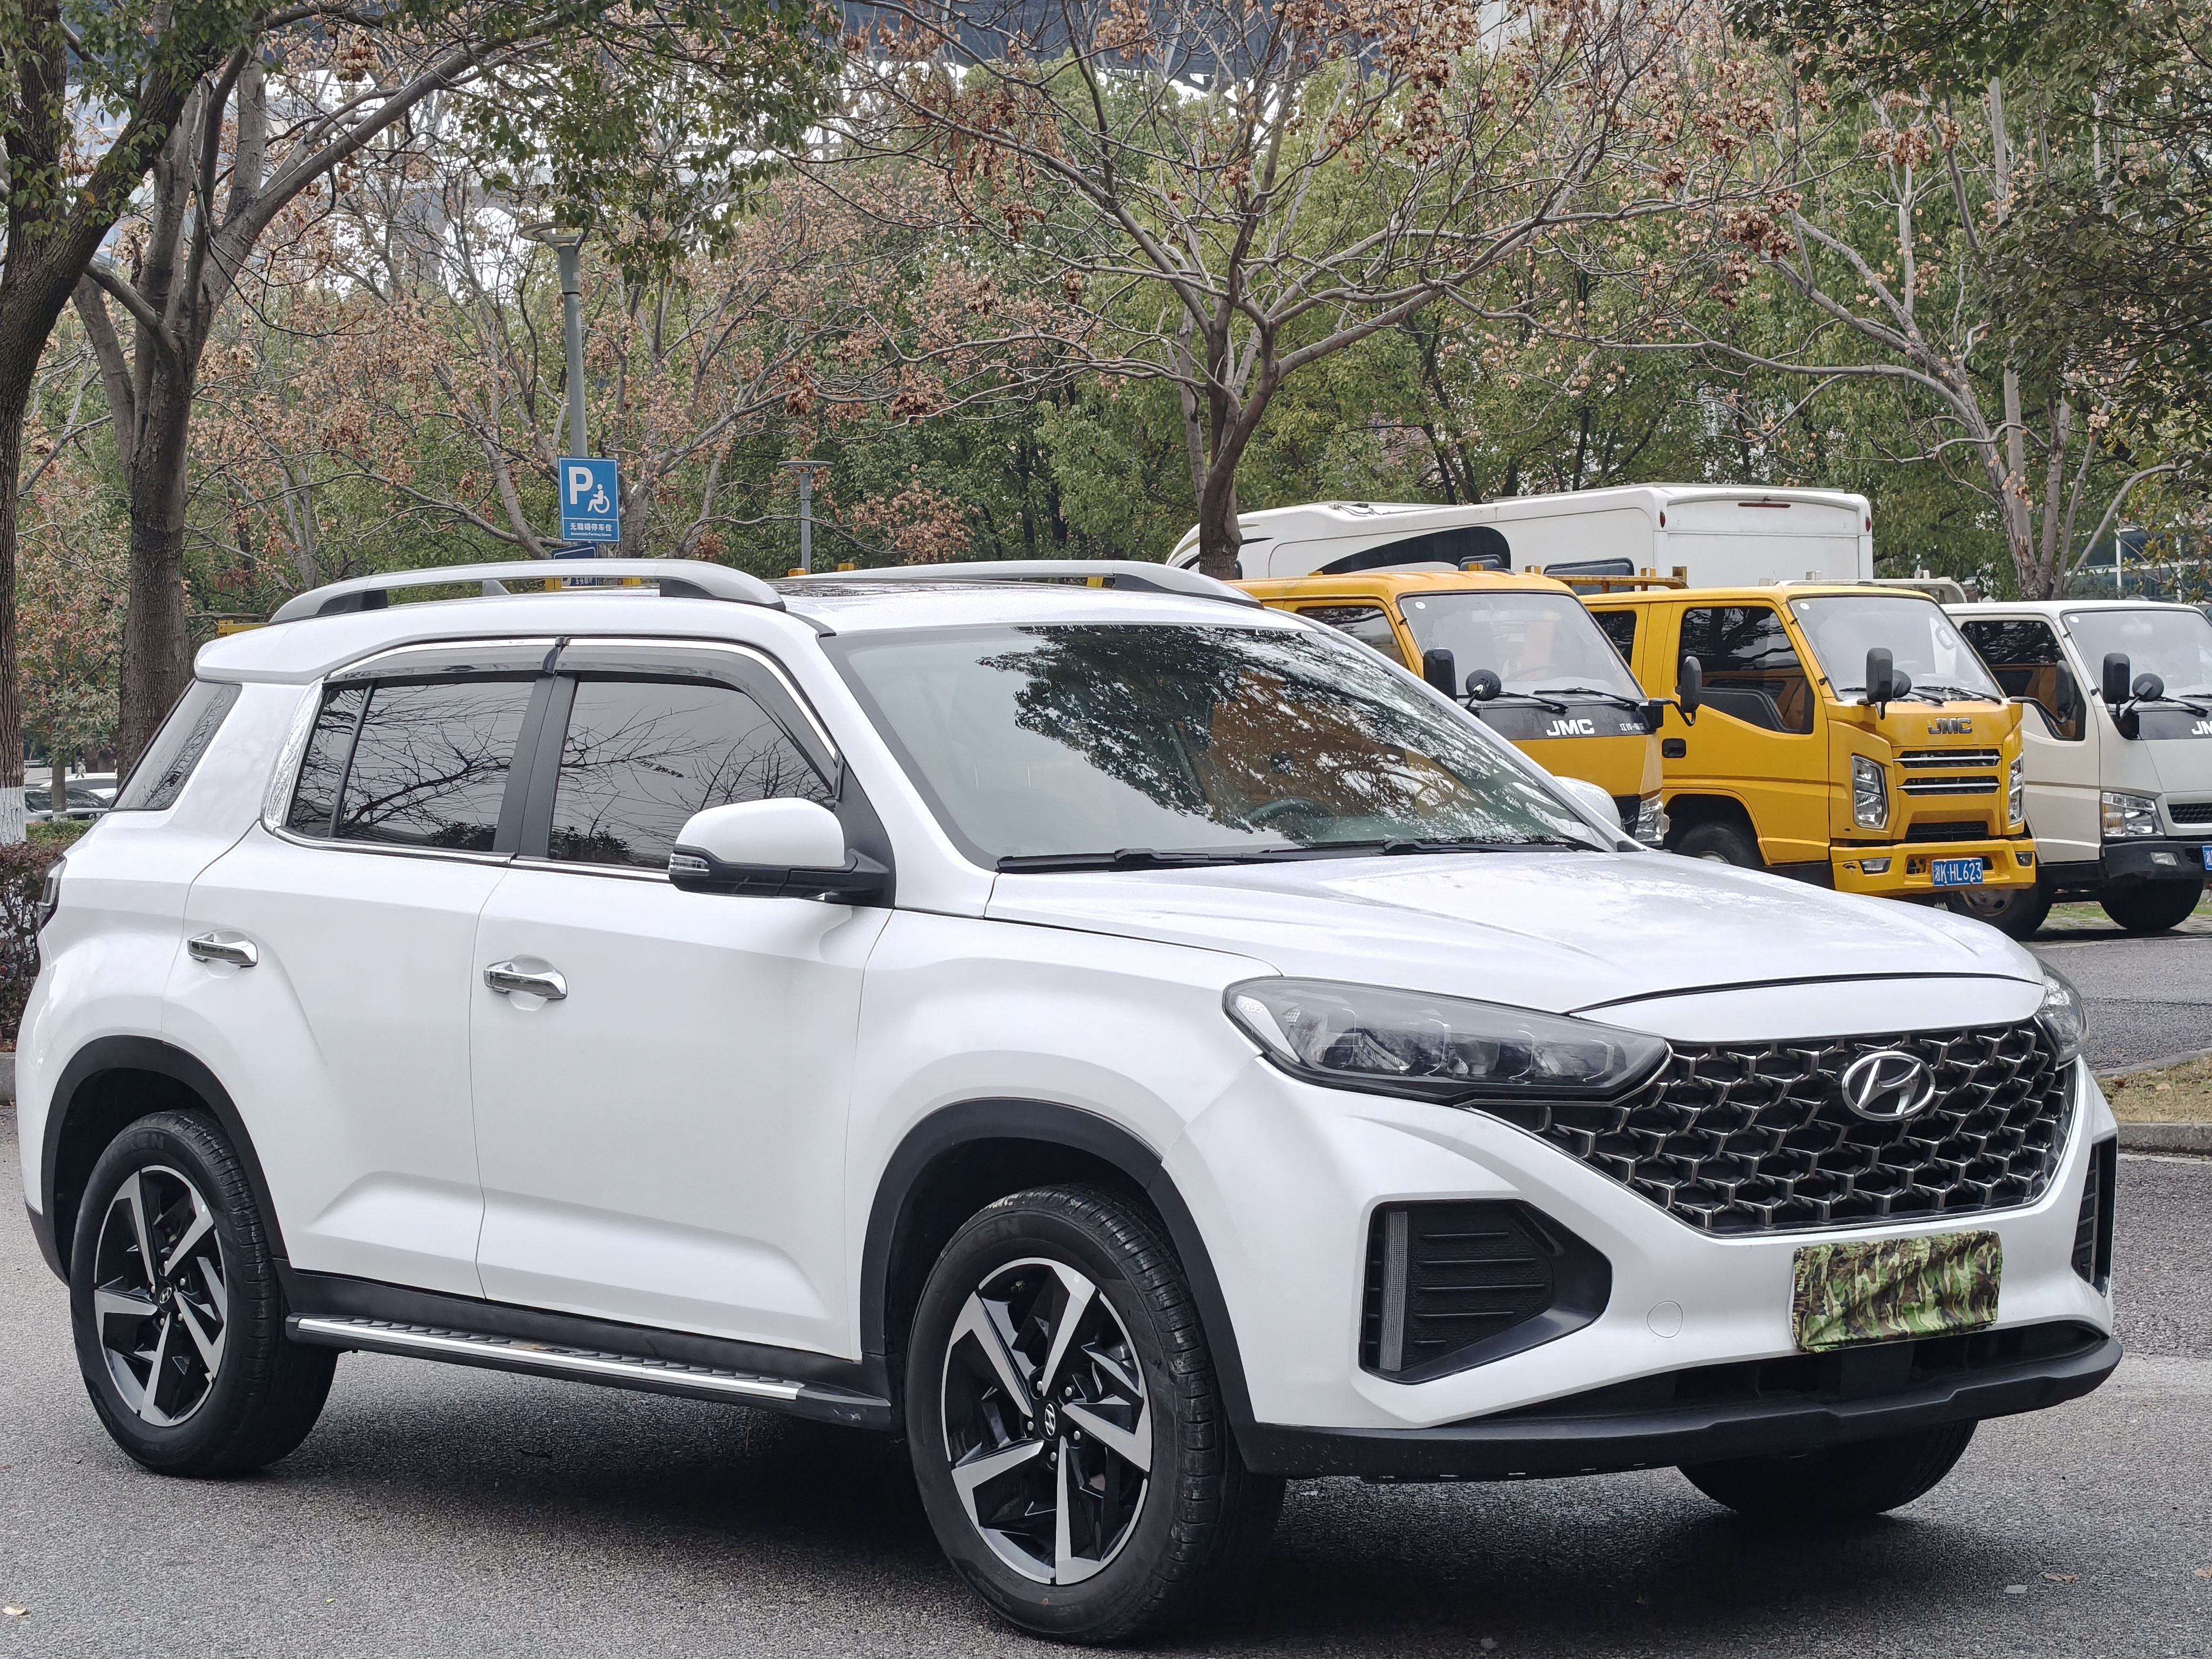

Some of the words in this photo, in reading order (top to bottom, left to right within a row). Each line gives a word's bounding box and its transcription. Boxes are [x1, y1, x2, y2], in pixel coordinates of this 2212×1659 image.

[569, 466, 594, 505] P
[1546, 719, 1595, 736] JMC
[1927, 717, 1972, 734] JMC
